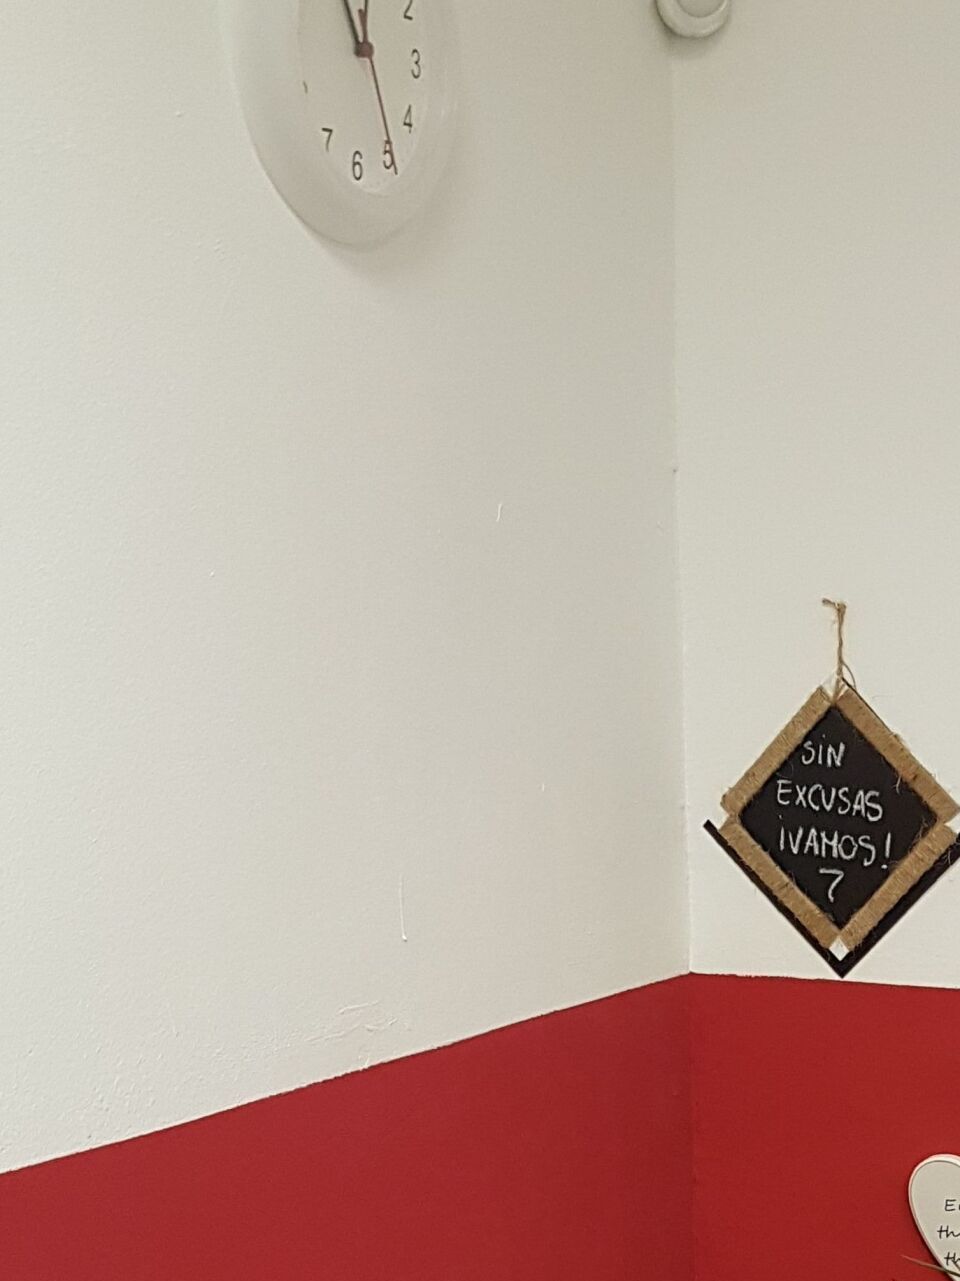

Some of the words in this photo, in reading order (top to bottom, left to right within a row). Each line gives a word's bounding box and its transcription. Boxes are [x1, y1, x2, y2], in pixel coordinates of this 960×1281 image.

[411, 48, 422, 80] 3
[403, 103, 414, 135] 4
[321, 126, 334, 153] 7
[352, 150, 364, 181] 6
[776, 779, 884, 823] EXCUSAS
